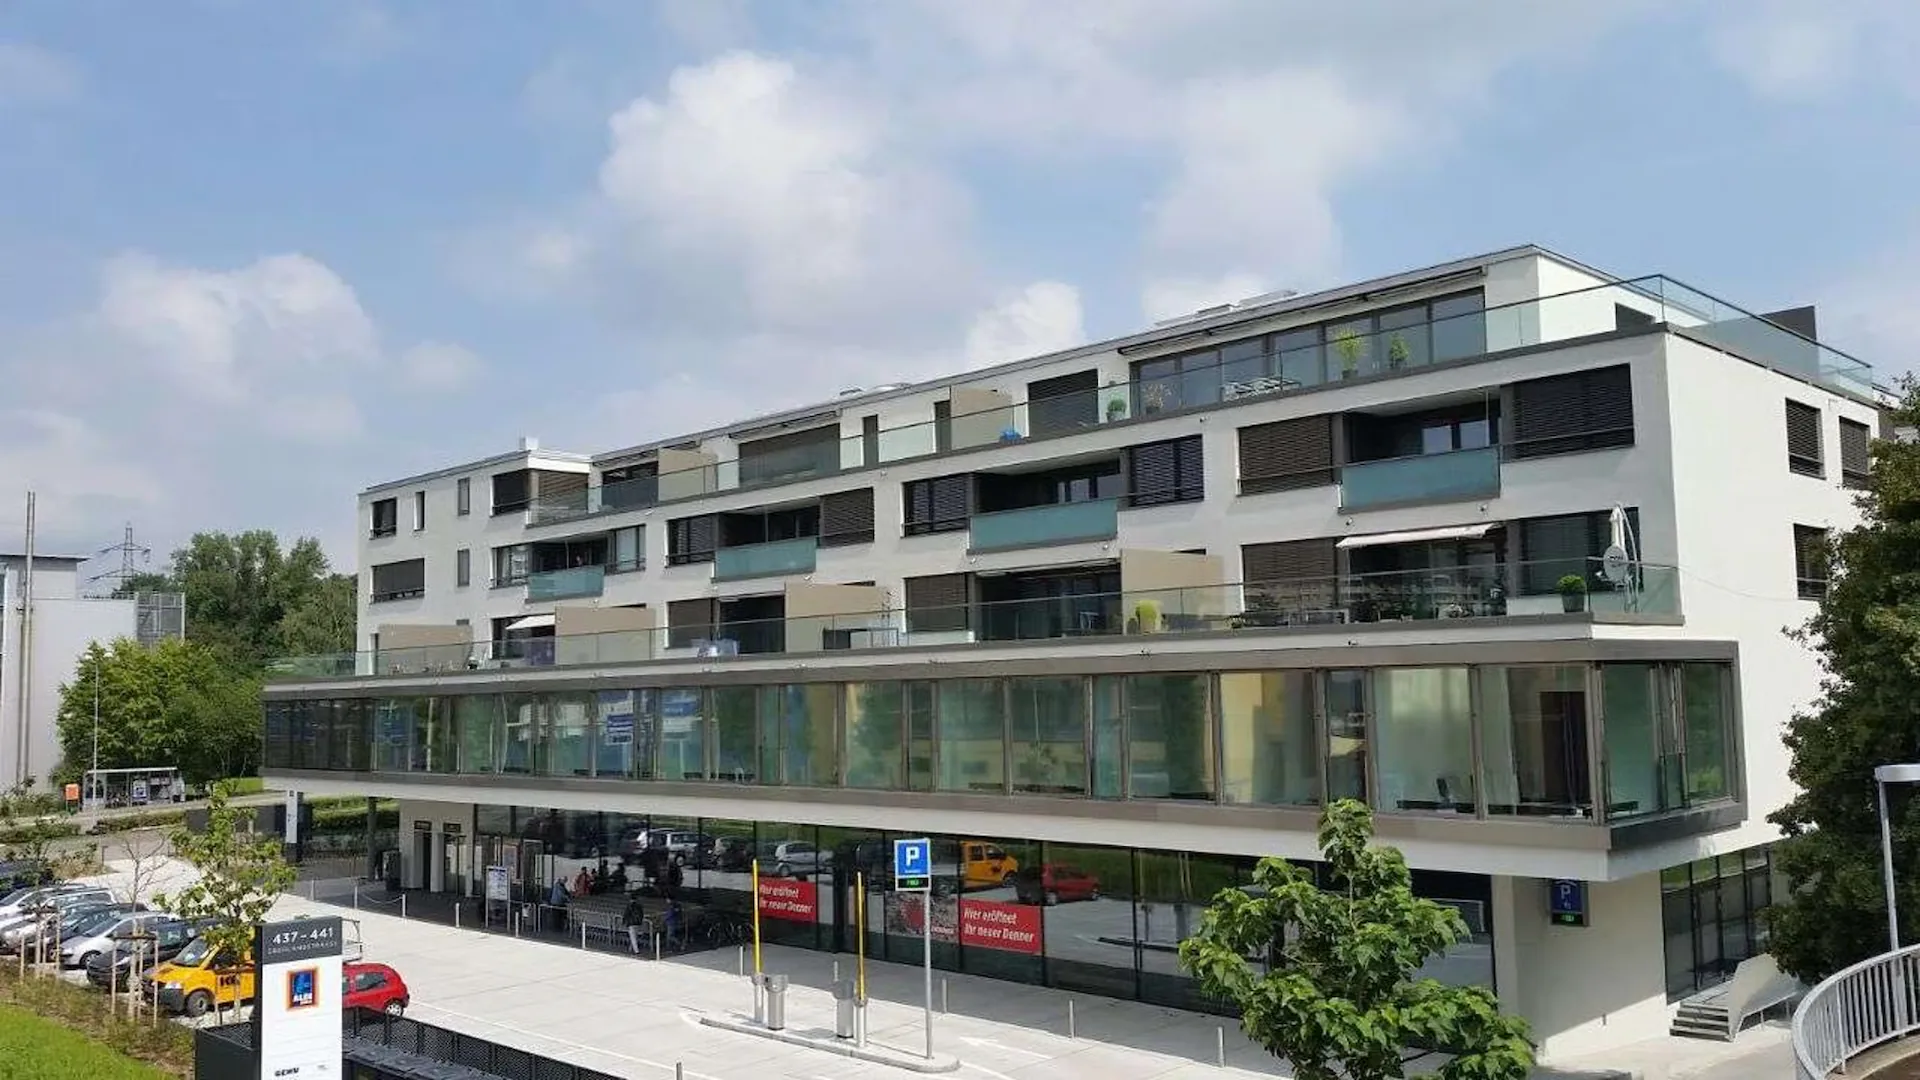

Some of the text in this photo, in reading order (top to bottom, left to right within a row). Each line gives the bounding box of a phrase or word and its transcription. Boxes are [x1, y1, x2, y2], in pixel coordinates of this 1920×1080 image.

[905, 846, 920, 867] P
[1560, 884, 1571, 900] P
[963, 907, 1017, 925] Hier eröffnet
[964, 923, 977, 936] Ihr
[977, 926, 1002, 939] neuer
[1002, 927, 1035, 943] Denner
